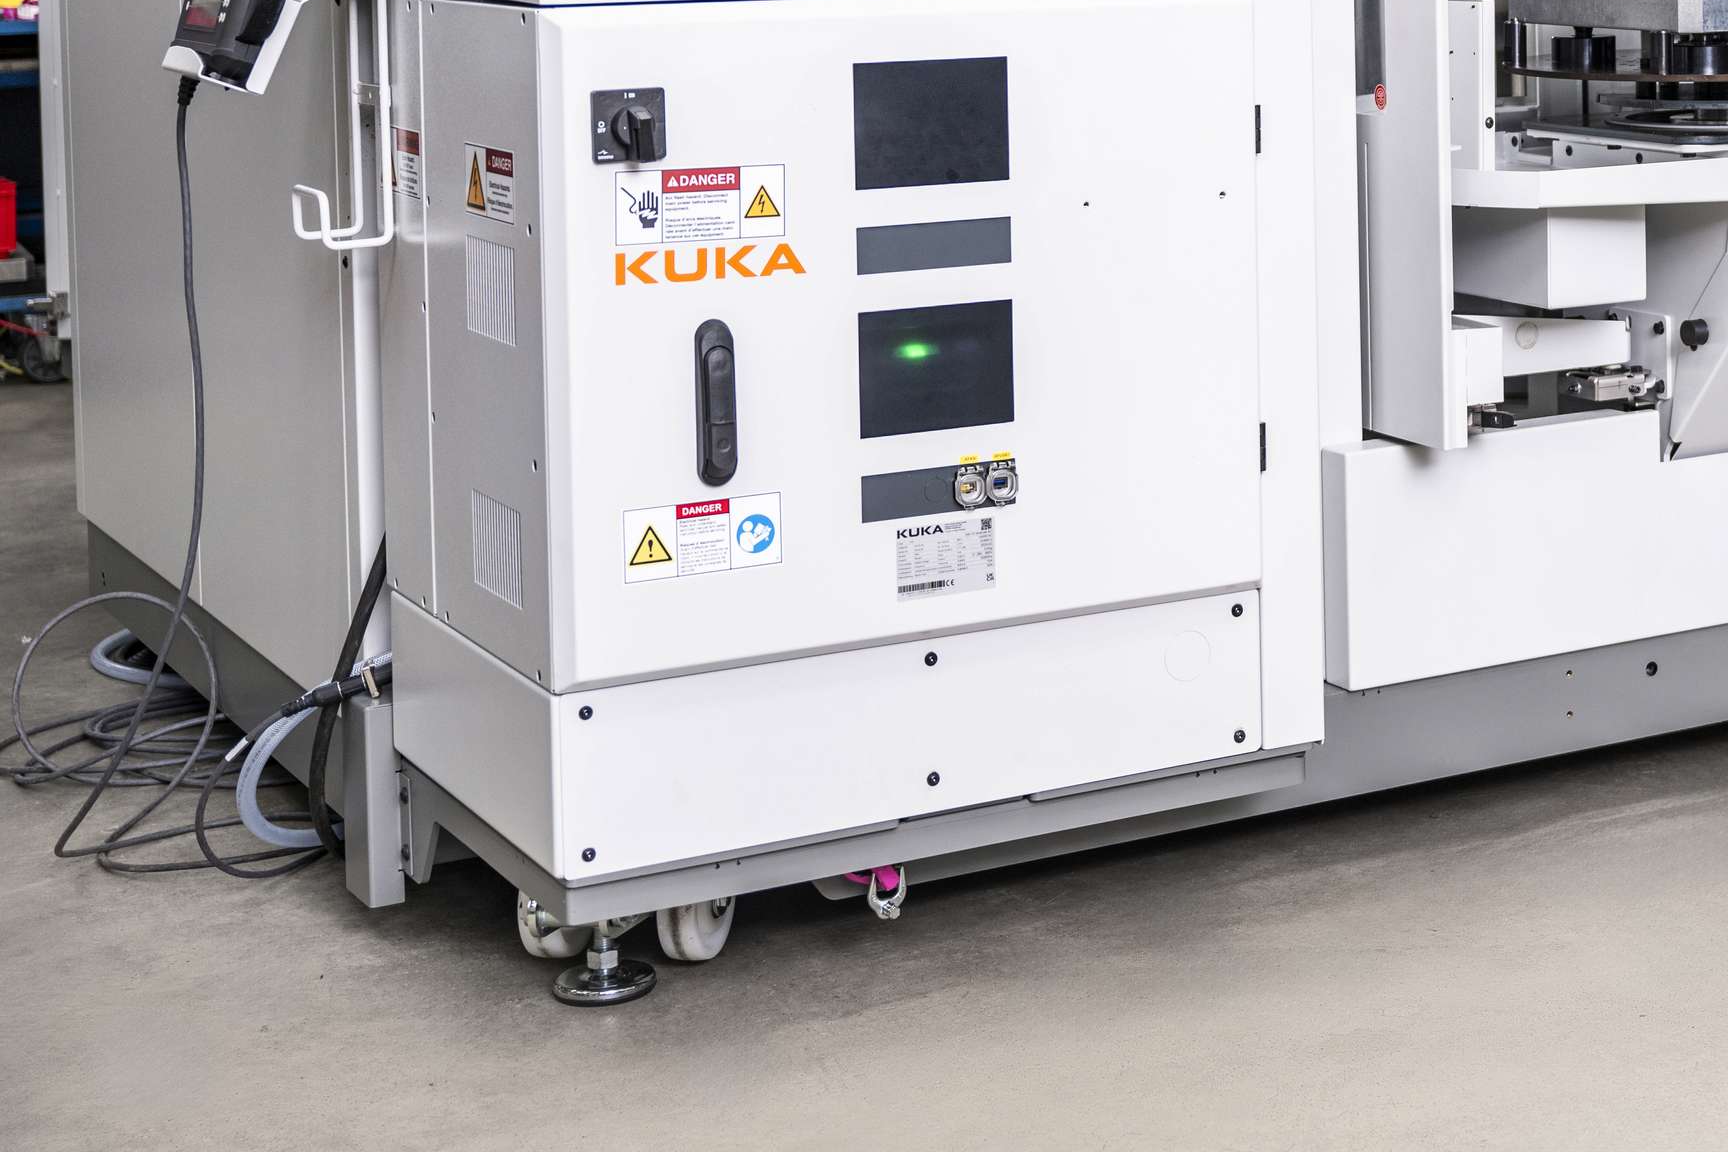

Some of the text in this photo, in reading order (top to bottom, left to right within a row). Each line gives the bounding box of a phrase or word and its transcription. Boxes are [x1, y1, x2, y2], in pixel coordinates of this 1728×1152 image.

[491, 155, 512, 171] DANGER
[679, 173, 736, 187] DANGER
[615, 243, 807, 286] KUKA
[682, 503, 722, 516] DANGER
[896, 524, 944, 540] KUKA
